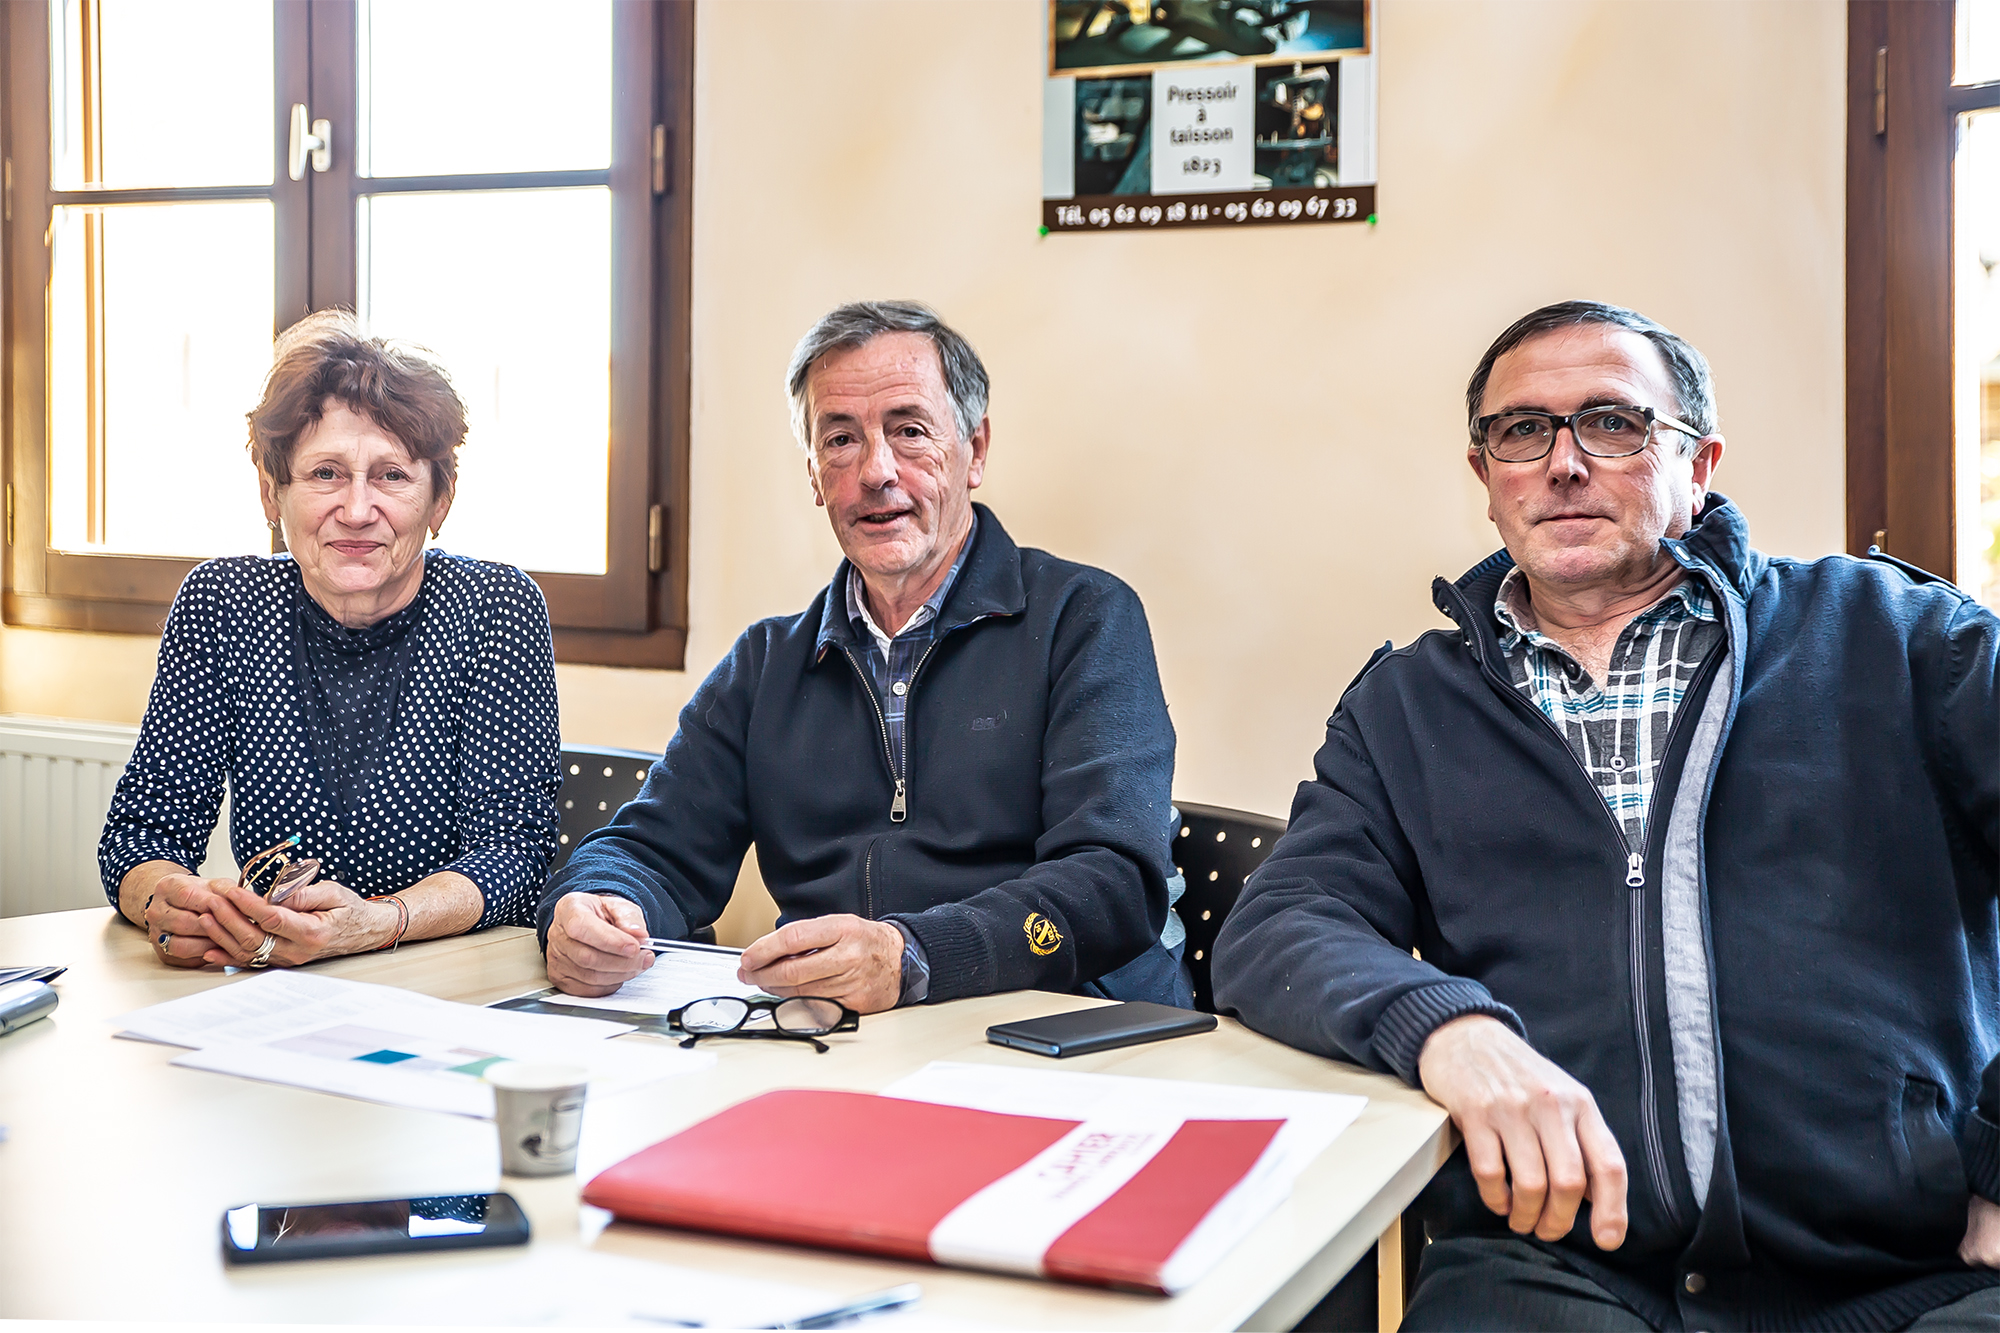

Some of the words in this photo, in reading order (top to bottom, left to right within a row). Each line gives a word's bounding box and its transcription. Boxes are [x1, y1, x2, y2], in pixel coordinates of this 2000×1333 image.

[1167, 81, 1239, 103] Pressoir
[1196, 104, 1207, 124] à
[1170, 126, 1233, 146] taisson
[1182, 156, 1221, 177] 1823
[1055, 204, 1086, 226] Tél.
[1089, 207, 1111, 228] 05
[1113, 203, 1136, 224] 62
[1139, 205, 1162, 226] 09
[1165, 201, 1187, 222] 18
[1189, 203, 1209, 221] 11
[1224, 202, 1248, 222] 05
[1251, 197, 1275, 218] 62
[1278, 199, 1303, 220] 09
[1305, 195, 1329, 219] 67
[1332, 197, 1357, 219] 33
